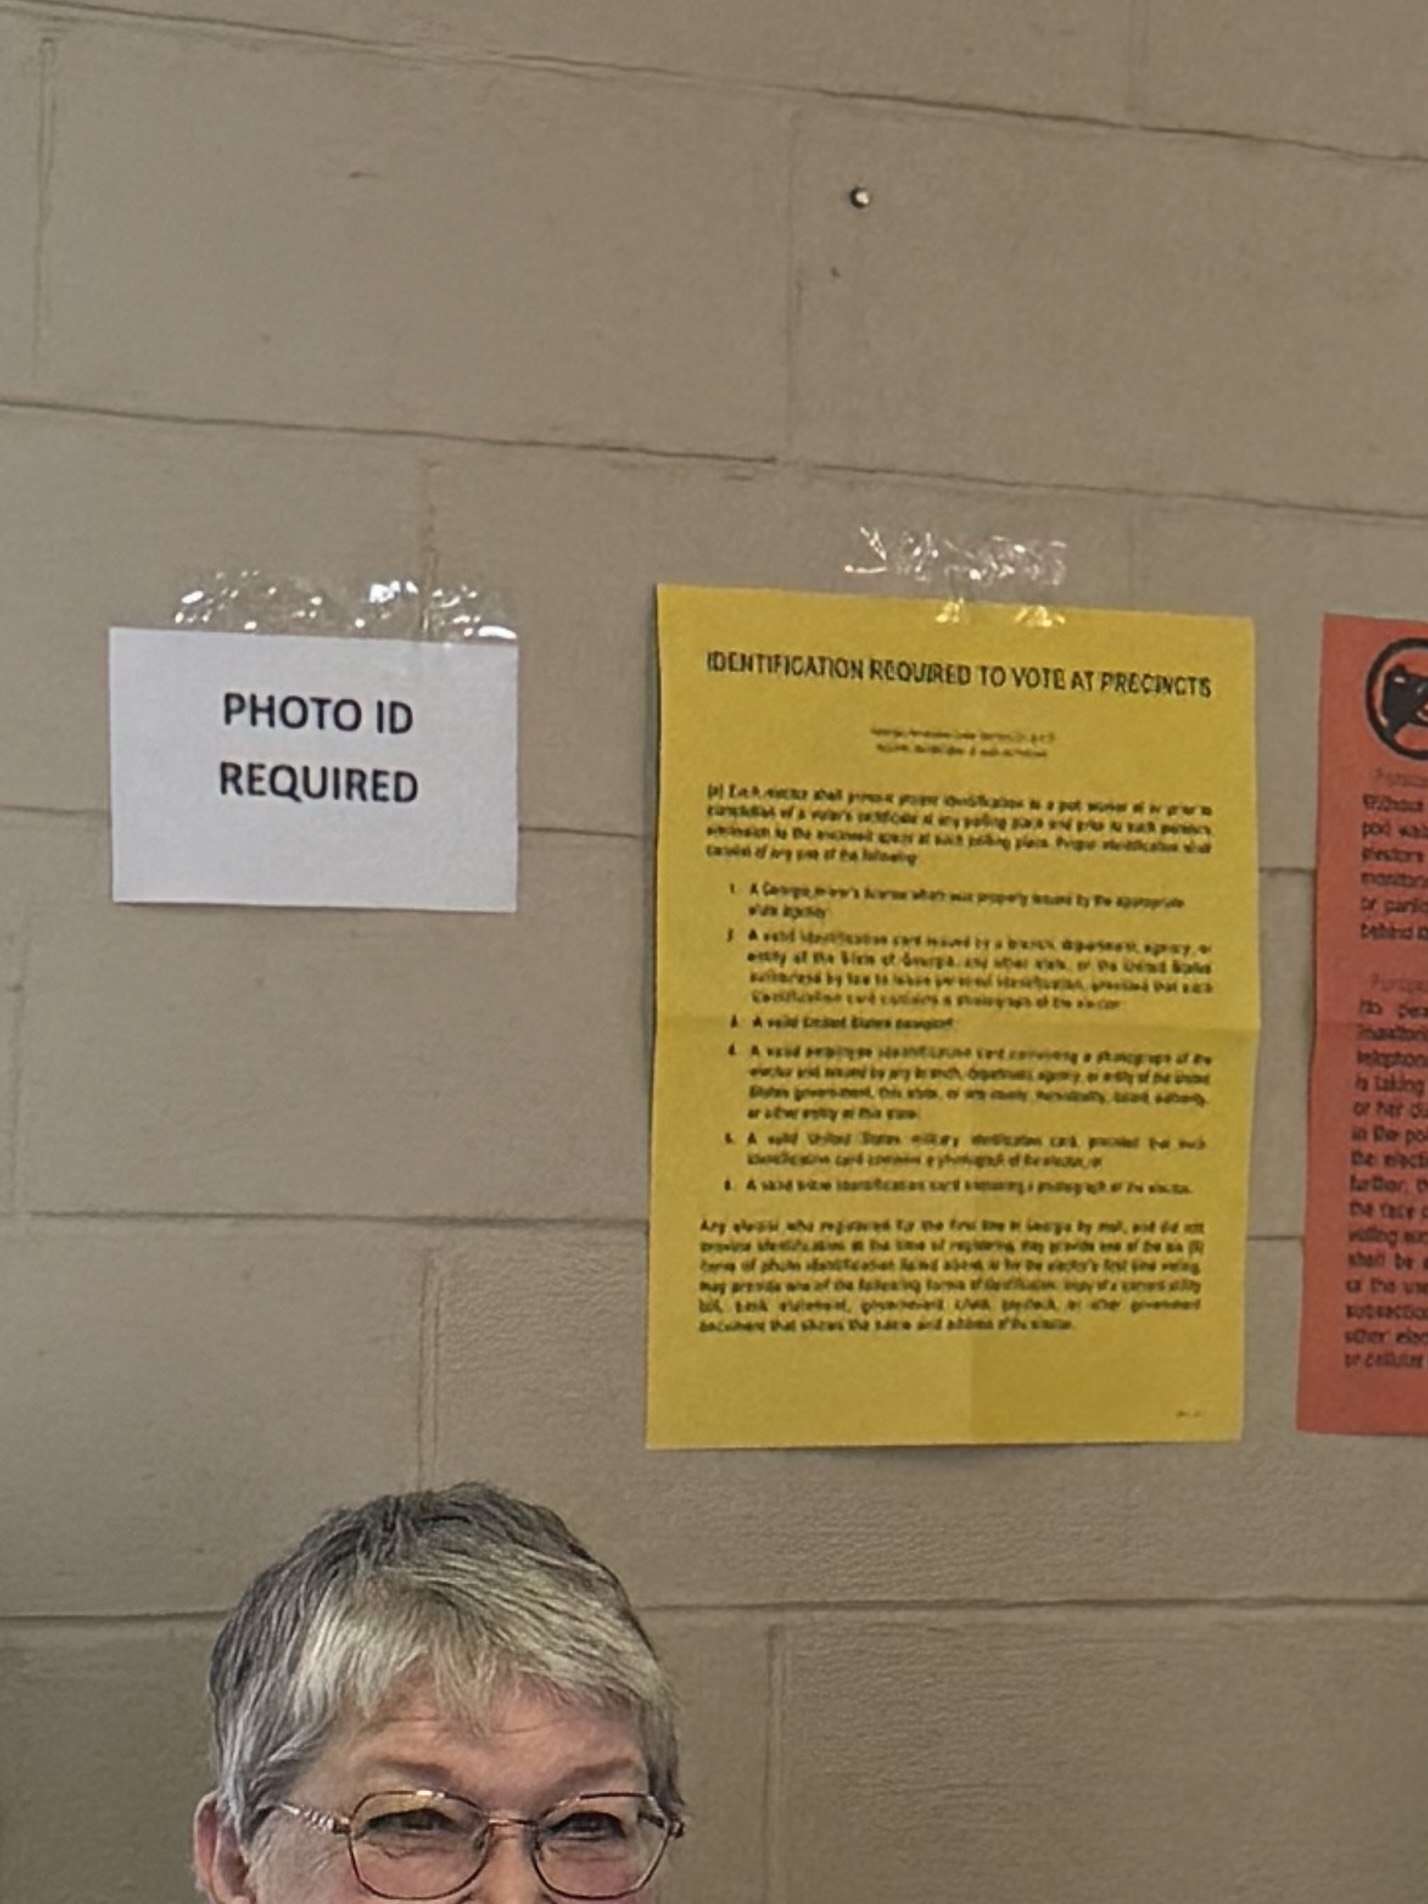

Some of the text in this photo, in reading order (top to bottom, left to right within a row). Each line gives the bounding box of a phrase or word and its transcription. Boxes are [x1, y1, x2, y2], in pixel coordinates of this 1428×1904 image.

[706, 650, 1210, 696] IDENTIFICATION REQUIRED TO VOTE AT PRECINCTS
[223, 692, 414, 735] PHOTO ID
[219, 761, 419, 804] REQUIRED
